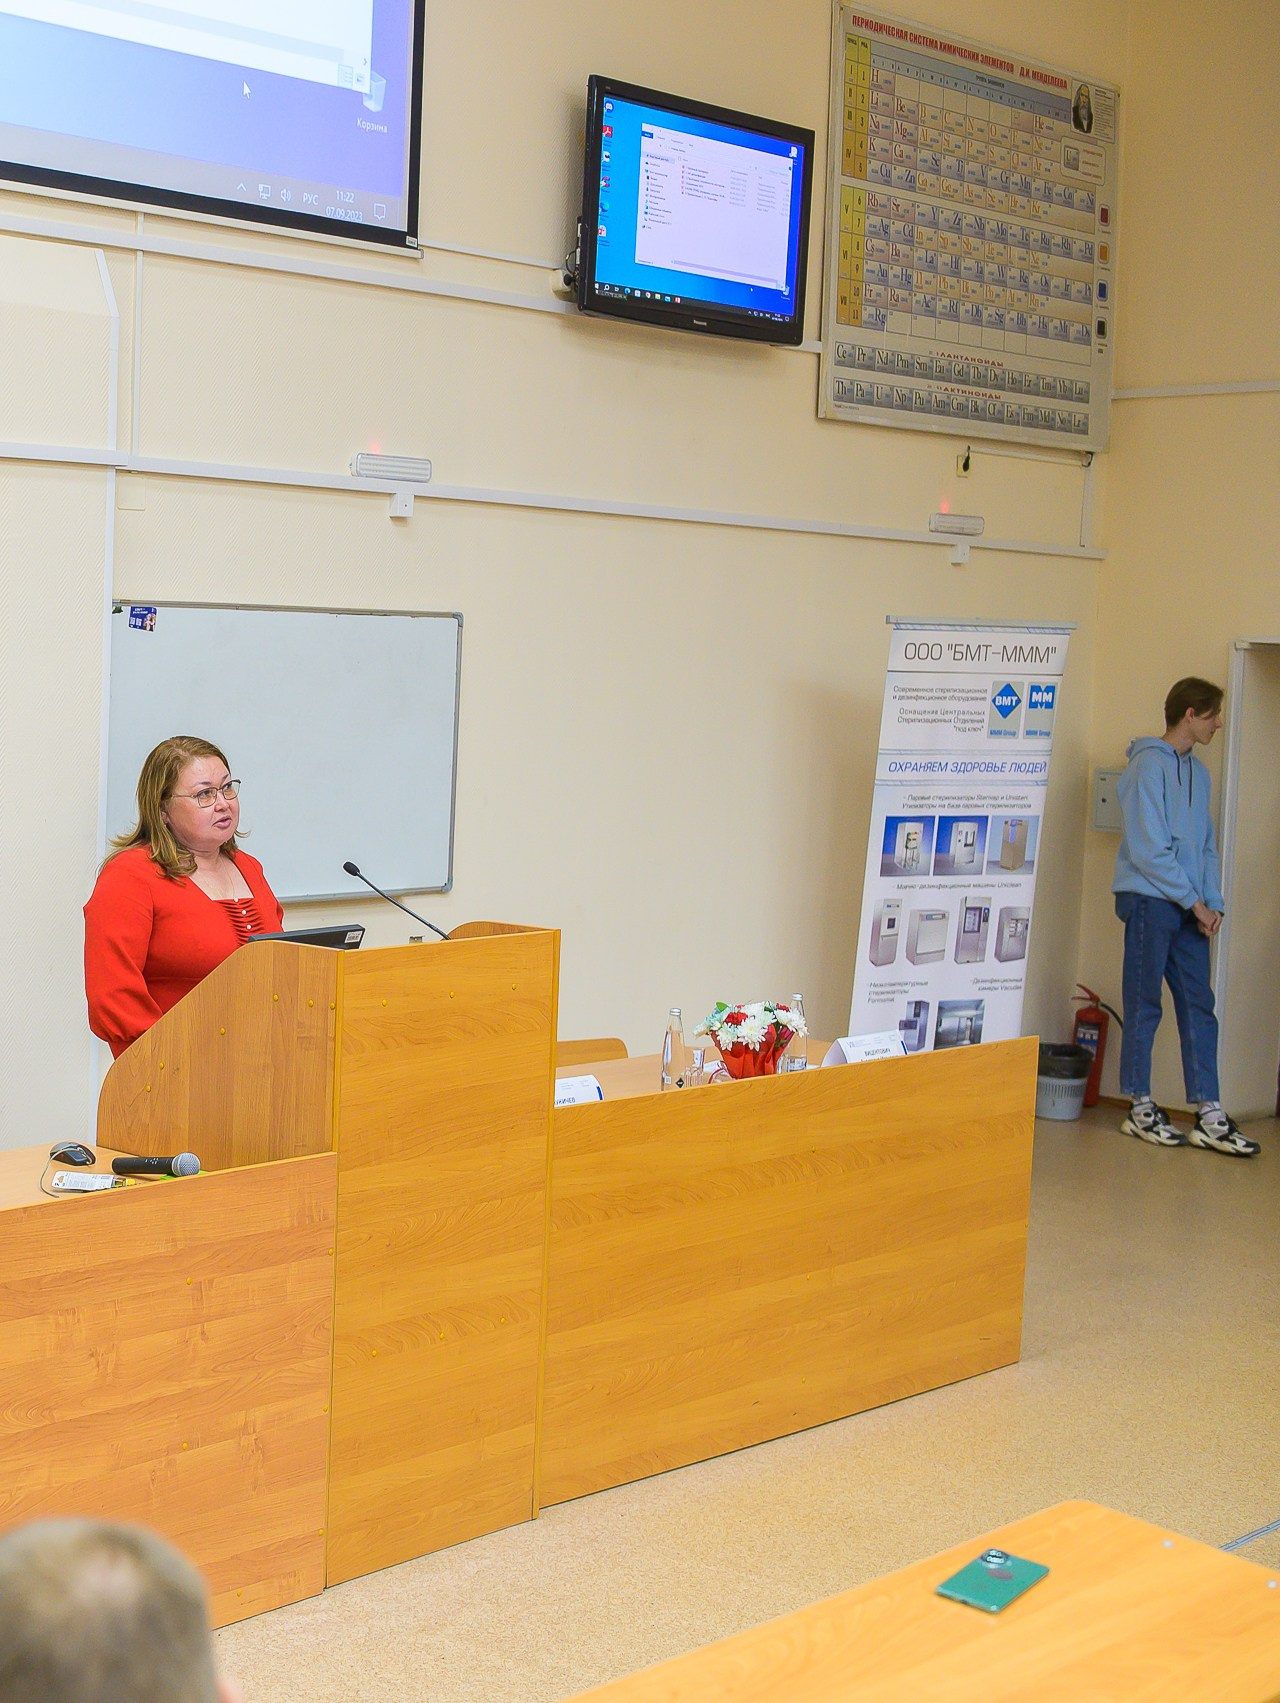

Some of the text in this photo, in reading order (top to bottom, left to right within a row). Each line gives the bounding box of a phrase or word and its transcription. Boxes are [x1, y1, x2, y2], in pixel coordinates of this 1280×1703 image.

[852, 15, 908, 41] ПЕРИОДИЧЕСКАЯ
[909, 31, 938, 50] СИСТЕМА
[939, 41, 980, 62] ХИМИЧЕСКИХ
[980, 54, 1015, 74] ЭЛЕМЕНТОВ
[1031, 70, 1068, 89] МЕНДЕЛЕЕВА
[872, 69, 879, 83] H
[870, 91, 879, 106] Li
[896, 96, 905, 112] Be
[357, 117, 388, 133] Корзина
[870, 112, 879, 129] Na
[895, 120, 907, 139] Mg
[869, 137, 875, 152] K
[894, 143, 904, 159] Ca
[1000, 170, 1009, 184] Cr
[880, 163, 891, 178] Cu
[904, 169, 916, 184] Zn
[303, 190, 355, 206] РУС 11:22
[867, 192, 879, 207] Rb
[931, 206, 938, 220] Y
[325, 206, 363, 222] 07.09.2023
[879, 219, 889, 236] Ag
[903, 224, 913, 238] Cd
[865, 238, 874, 253] Cs
[997, 265, 1006, 278] W
[900, 268, 911, 285] Hg
[864, 283, 873, 298] Fr
[889, 287, 899, 302] Ra
[837, 344, 846, 359] Ce
[857, 347, 866, 362] Pr
[877, 350, 888, 365] Nd
[896, 354, 908, 368] Pm
[915, 357, 927, 371] Sm
[953, 363, 963, 377] Gd
[972, 365, 981, 380] Tb
[836, 380, 846, 395] Th
[856, 383, 865, 398] Pa
[895, 389, 906, 405] Np
[951, 397, 963, 411] Cm
[904, 642, 1057, 664] ООО "БМТ-МММ"
[893, 685, 988, 695] Современное стерилизационное
[948, 694, 987, 702] оборудование
[995, 696, 1018, 706] BMT
[897, 716, 985, 724] Стерилизационных Отделений
[899, 707, 985, 716] Оснащение Центральных
[888, 760, 1047, 775] ОХРАНЯЕМ ЗДОРОВЬЕ ЛЮДЕЙ
